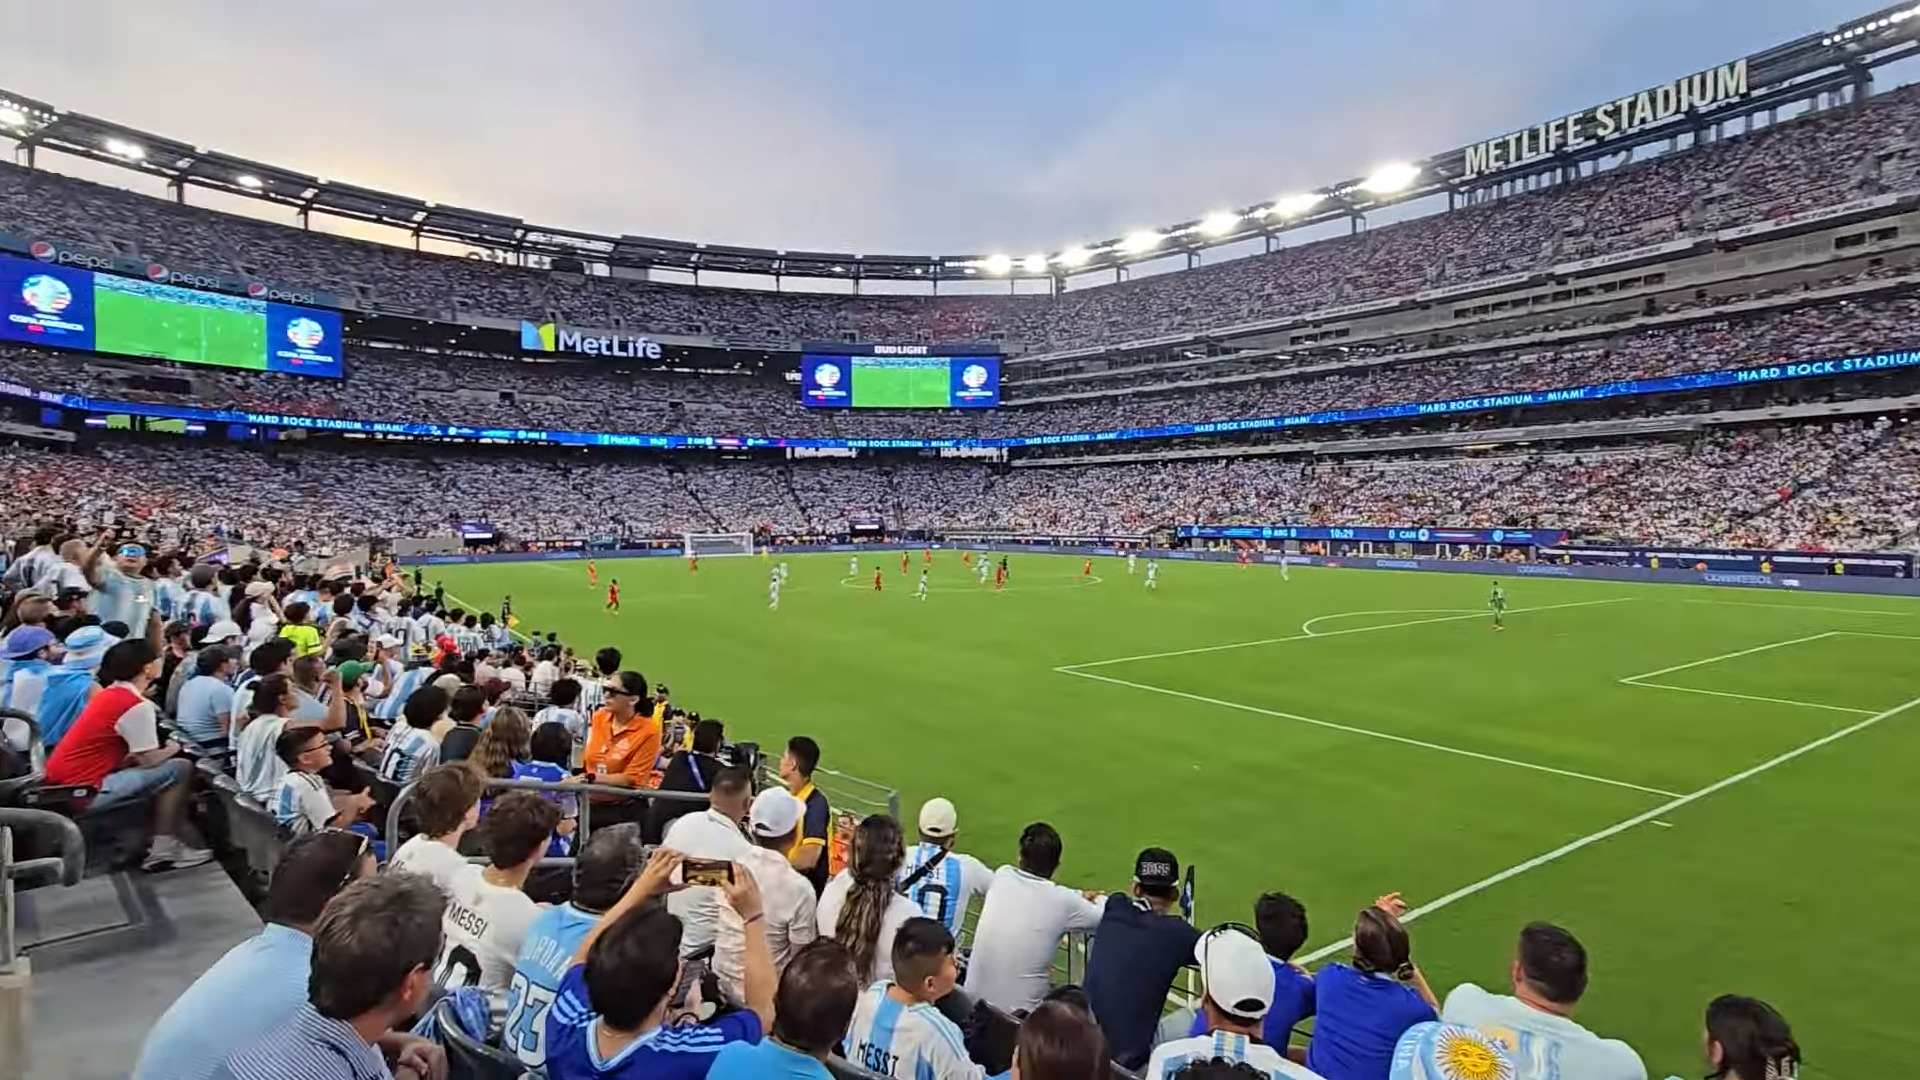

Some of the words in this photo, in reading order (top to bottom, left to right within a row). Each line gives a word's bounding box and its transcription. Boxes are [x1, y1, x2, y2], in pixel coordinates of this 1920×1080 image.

[1465, 113, 1585, 176] METLIFE
[1595, 59, 1748, 136] STADIUM
[58, 251, 114, 269] pepsi
[170, 271, 219, 288] pepsi
[269, 289, 314, 304] pepsi
[558, 329, 662, 359] MetLife
[1738, 367, 1780, 382] HARD
[1787, 360, 1835, 375] ROCK
[1842, 352, 1920, 370] STADIUM
[1419, 403, 1447, 413] HARD
[1450, 400, 1480, 410] ROCK
[1483, 394, 1532, 407] STADIUM
[1548, 389, 1584, 400] MIAMI
[249, 413, 279, 424] HARD
[283, 416, 312, 426] ROCK
[316, 419, 362, 430] STADIUM
[373, 423, 404, 432] MIAMI
[1194, 424, 1214, 432] HARD
[1217, 422, 1238, 431] ROCK
[1240, 419, 1275, 429] STADIUM
[1284, 416, 1309, 424] MIAMI
[1330, 528, 1354, 538] 10:29
[1400, 530, 1416, 539] CAN
[1140, 861, 1171, 876] BOSS
[449, 902, 488, 939] MESSI
[504, 968, 559, 1069] 23
[857, 1039, 900, 1077] MESSI
